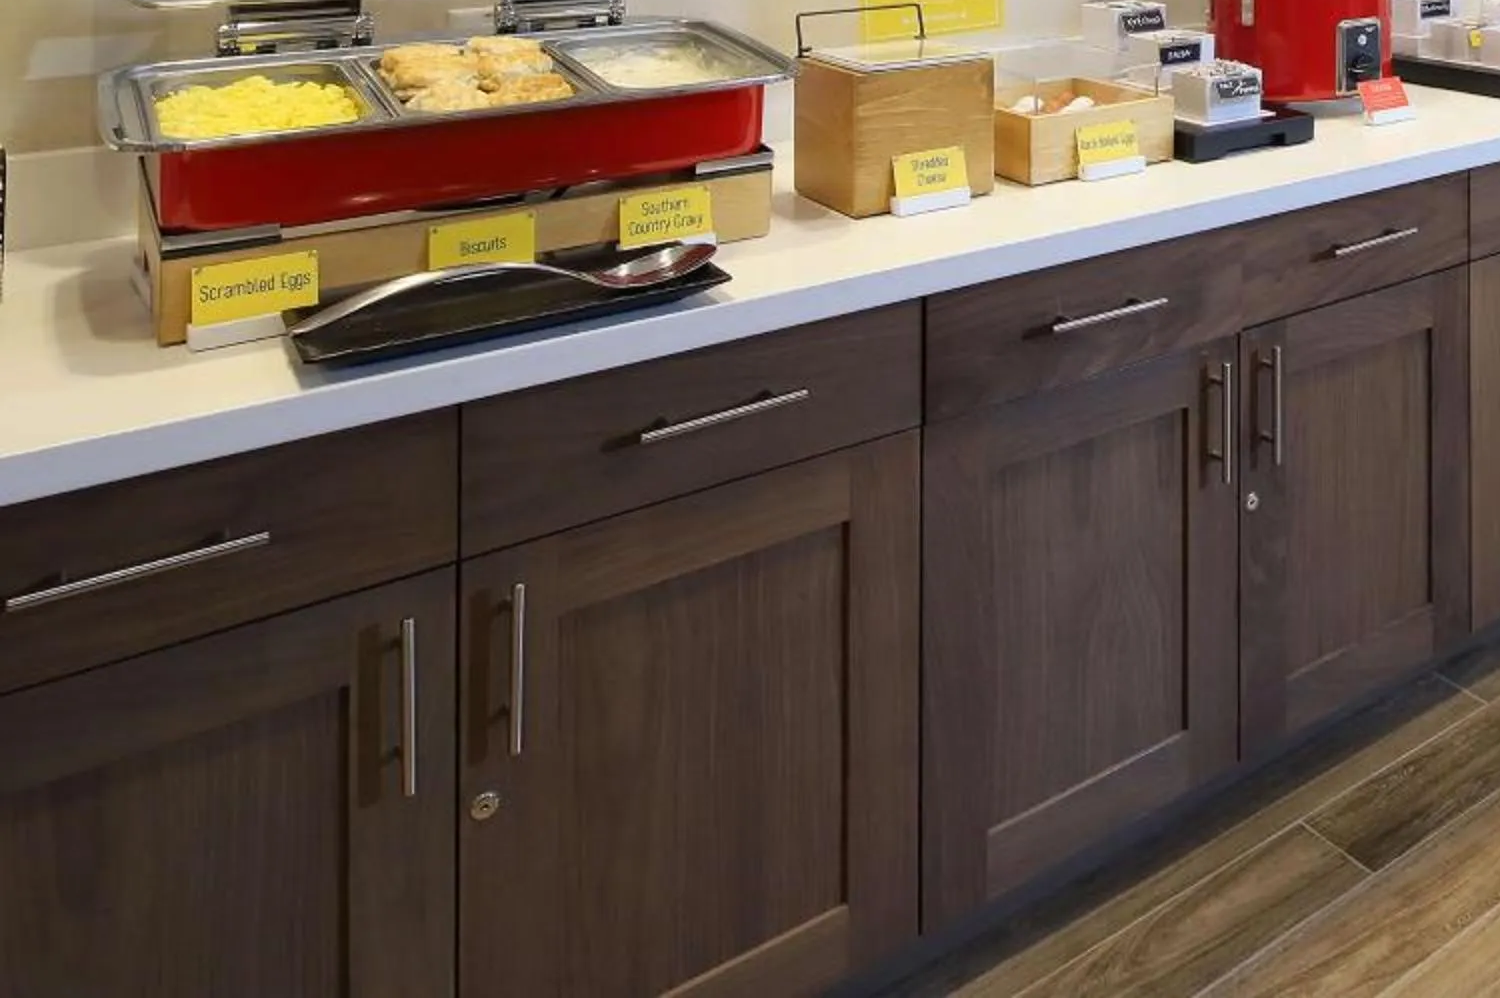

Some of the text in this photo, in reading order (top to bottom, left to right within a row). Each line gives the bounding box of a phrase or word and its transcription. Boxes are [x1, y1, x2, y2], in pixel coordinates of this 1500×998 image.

[627, 214, 703, 236] Country Gravy
[460, 235, 508, 257] Biscuits
[199, 271, 311, 303] Scrambled Eggs
